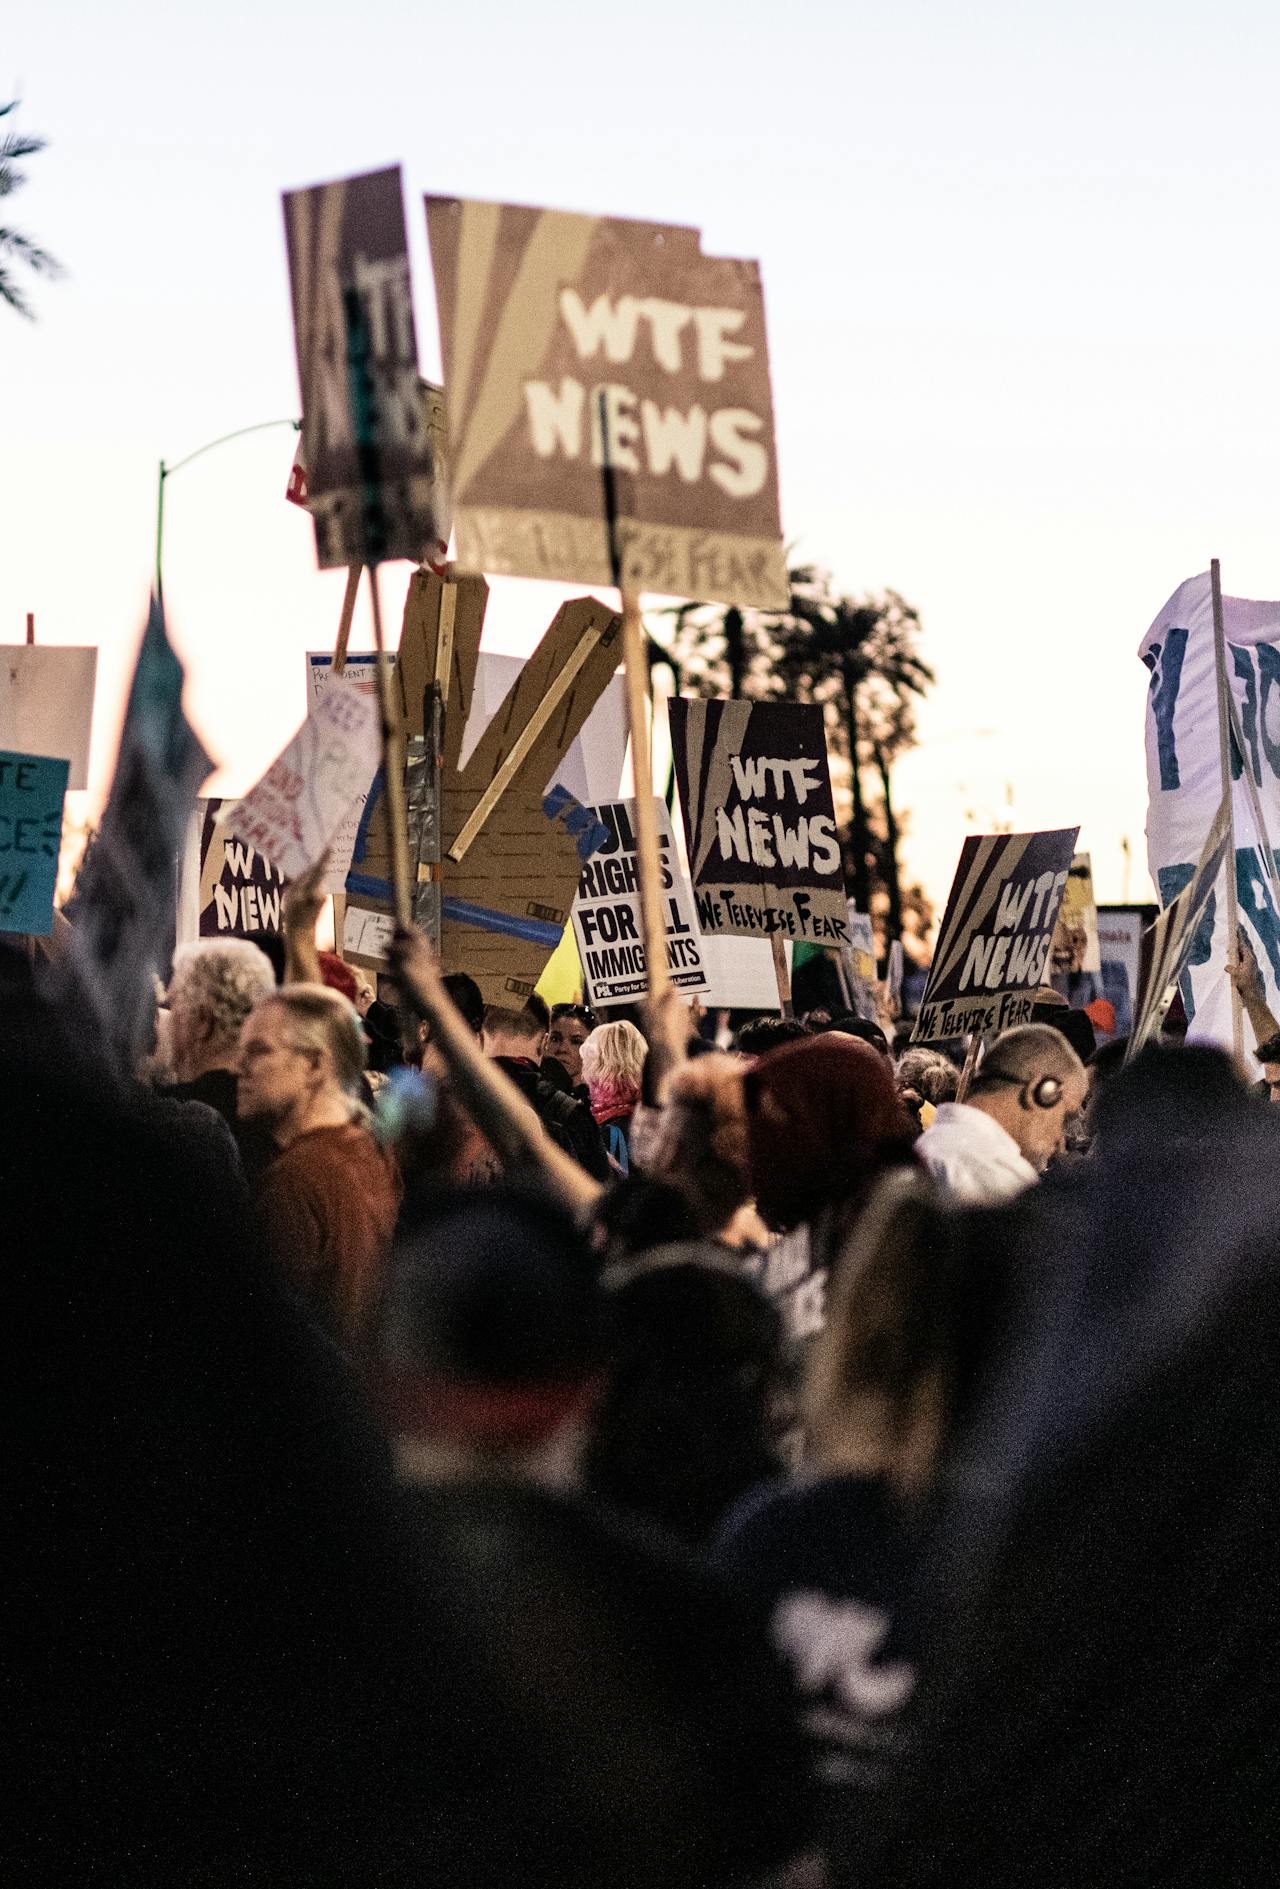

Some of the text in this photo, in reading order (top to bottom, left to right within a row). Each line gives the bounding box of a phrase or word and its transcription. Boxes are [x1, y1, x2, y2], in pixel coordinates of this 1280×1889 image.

[560, 287, 753, 382] WTF
[523, 376, 768, 497] NEWS
[728, 755, 823, 805] WTF
[717, 804, 841, 875] NEWS
[579, 853, 673, 899] RIGHS
[214, 883, 286, 934] NEW
[578, 904, 639, 946] FOR
[993, 870, 1069, 935] WTF
[586, 938, 700, 980] IMMIGNTS
[958, 933, 1051, 993] NEWS
[614, 982, 631, 994] Party
[631, 982, 641, 991] for
